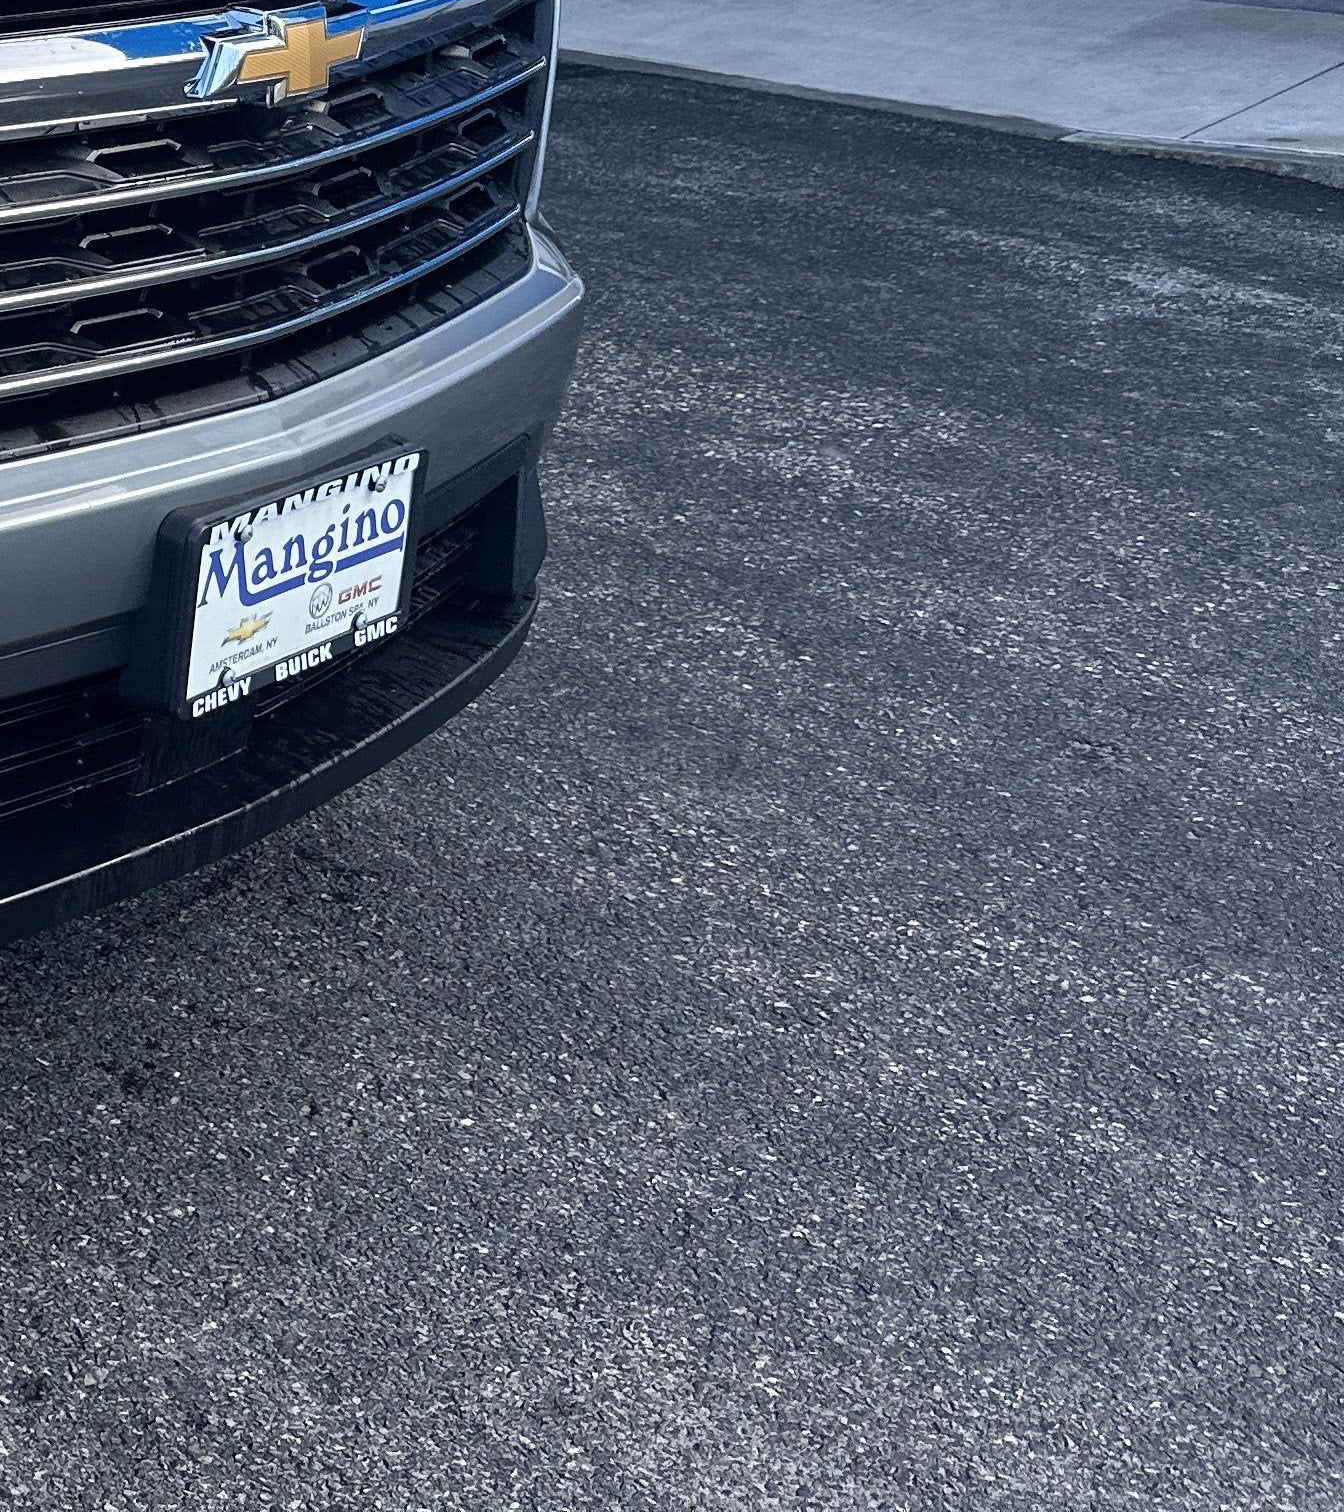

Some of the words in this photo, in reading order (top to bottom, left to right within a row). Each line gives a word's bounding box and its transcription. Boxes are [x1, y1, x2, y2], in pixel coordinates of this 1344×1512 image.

[210, 453, 420, 545] MANGINO
[197, 498, 405, 609] Mangino
[337, 575, 382, 605] GMC
[192, 676, 252, 718] CHEVY
[275, 642, 333, 682] BUICK
[354, 616, 398, 647] GMC
[266, 635, 279, 650] NY
